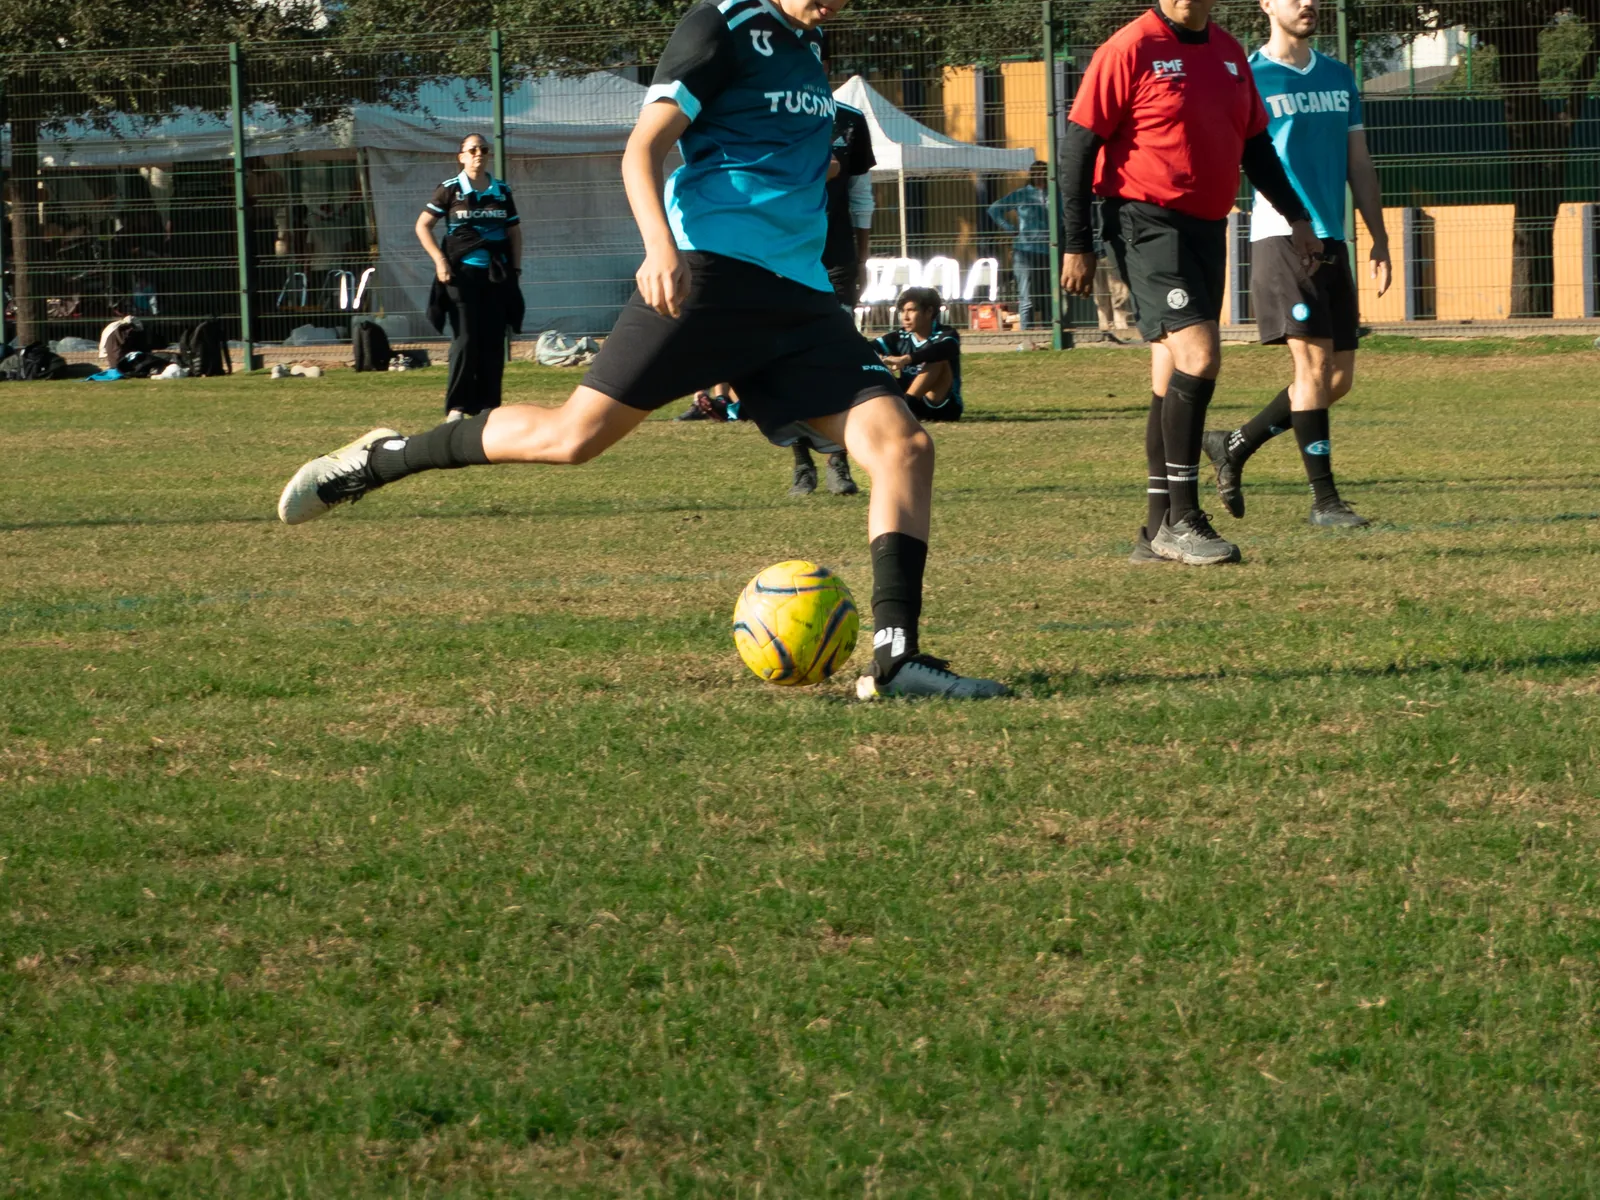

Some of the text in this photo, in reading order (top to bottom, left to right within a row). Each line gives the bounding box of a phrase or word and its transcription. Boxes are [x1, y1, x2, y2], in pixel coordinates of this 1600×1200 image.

[1152, 58, 1184, 75] FMF
[764, 90, 837, 121] TUCAN
[1265, 89, 1350, 118] TUCANES
